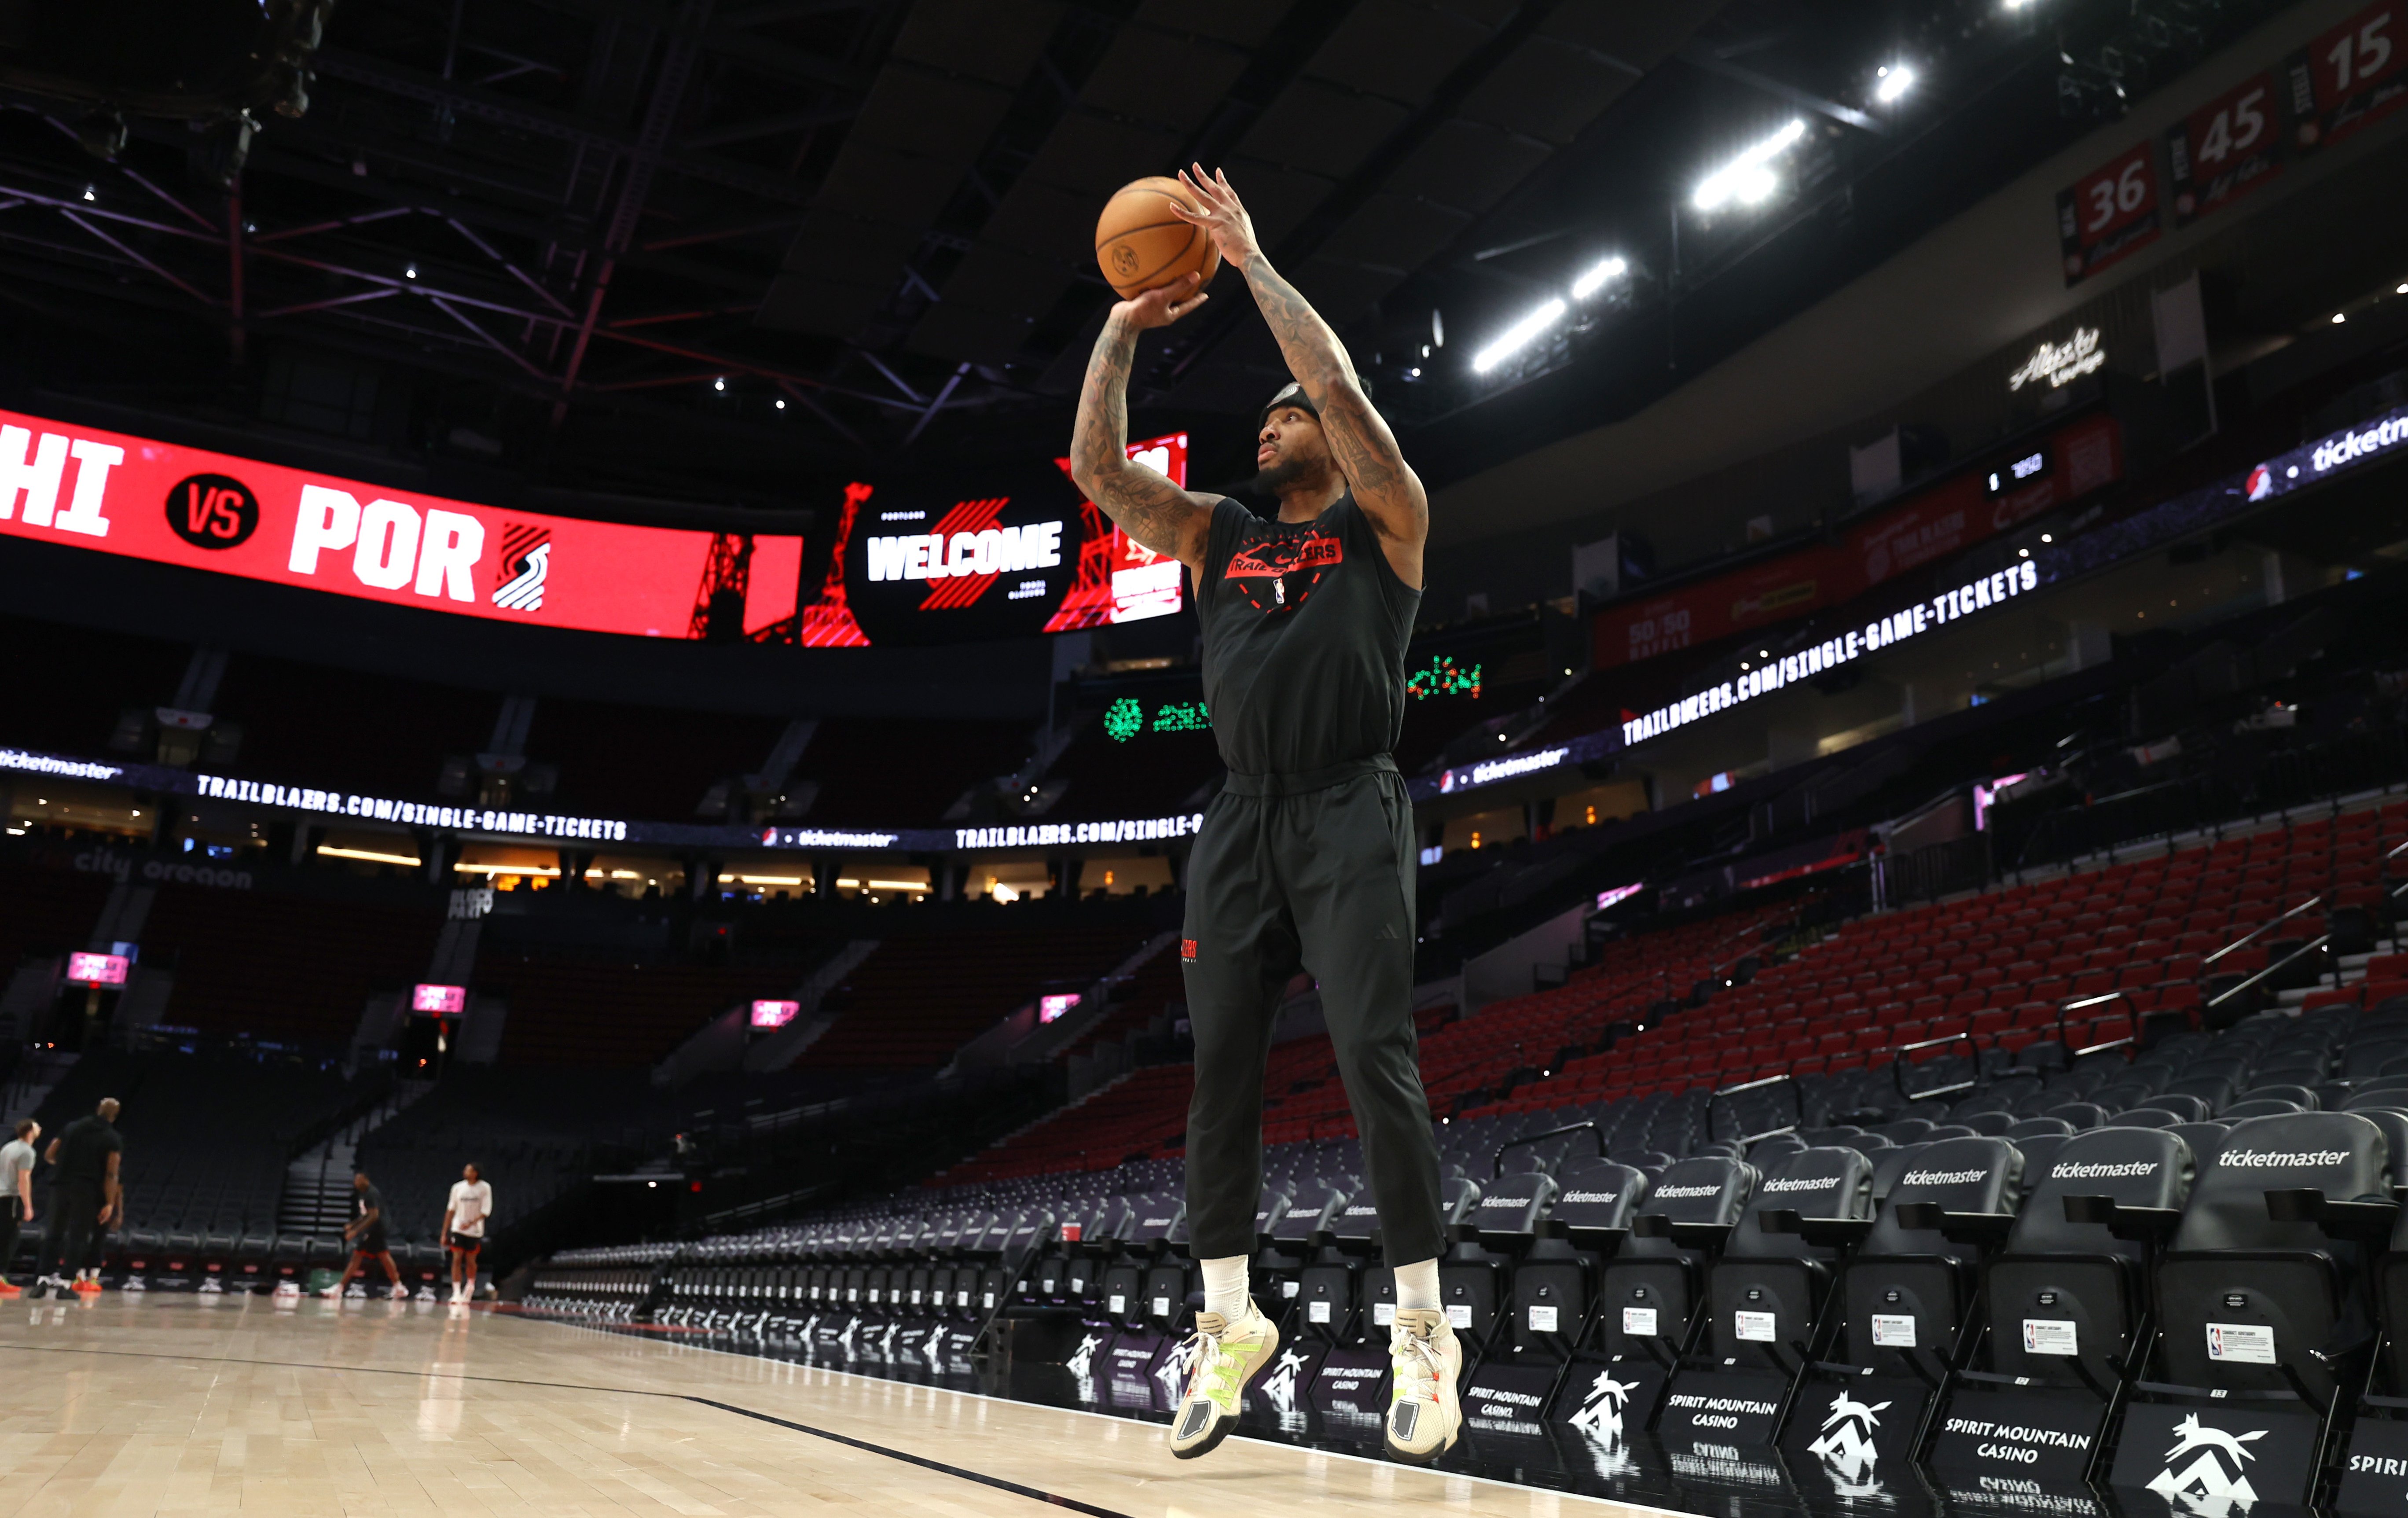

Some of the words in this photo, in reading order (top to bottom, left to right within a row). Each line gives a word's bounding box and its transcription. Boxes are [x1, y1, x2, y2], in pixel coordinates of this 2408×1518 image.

[2327, 12, 2391, 91] 15
[2198, 86, 2265, 163] 45
[2088, 159, 2145, 233] 36
[188, 483, 245, 539] VS
[288, 484, 485, 603] POR
[867, 521, 1063, 581] WELCOME
[1472, 748, 1563, 784] ticketmaster
[798, 829, 892, 848] ticketmaster
[2218, 1149, 2350, 1167] ticketmaster
[1903, 1169, 1987, 1185] ticketmaster
[2051, 1161, 2158, 1179] ticketmaster
[1654, 1184, 1721, 1198] ticketmaster
[1763, 1176, 1841, 1192] ticketmaster
[1481, 1196, 1531, 1207] ticketmaster
[1563, 1190, 1617, 1203] ticketmaster
[1321, 1367, 1343, 1377] SPIRIT
[1344, 1368, 1383, 1379] MOUNTAIN
[1332, 1380, 1359, 1390] CASINO
[1468, 1386, 1495, 1400] SPIRIT
[1495, 1389, 1542, 1408] MOUNTAIN
[1669, 1394, 1706, 1409] SPIRIT
[1708, 1397, 1777, 1416] MOUNTAIN
[1481, 1404, 1513, 1418] CASINO
[1692, 1414, 1738, 1430] CASINO
[1945, 1418, 1995, 1437] SPIRIT
[1993, 1425, 2091, 1451] MOUNTAIN
[1977, 1443, 2038, 1464] CASINO
